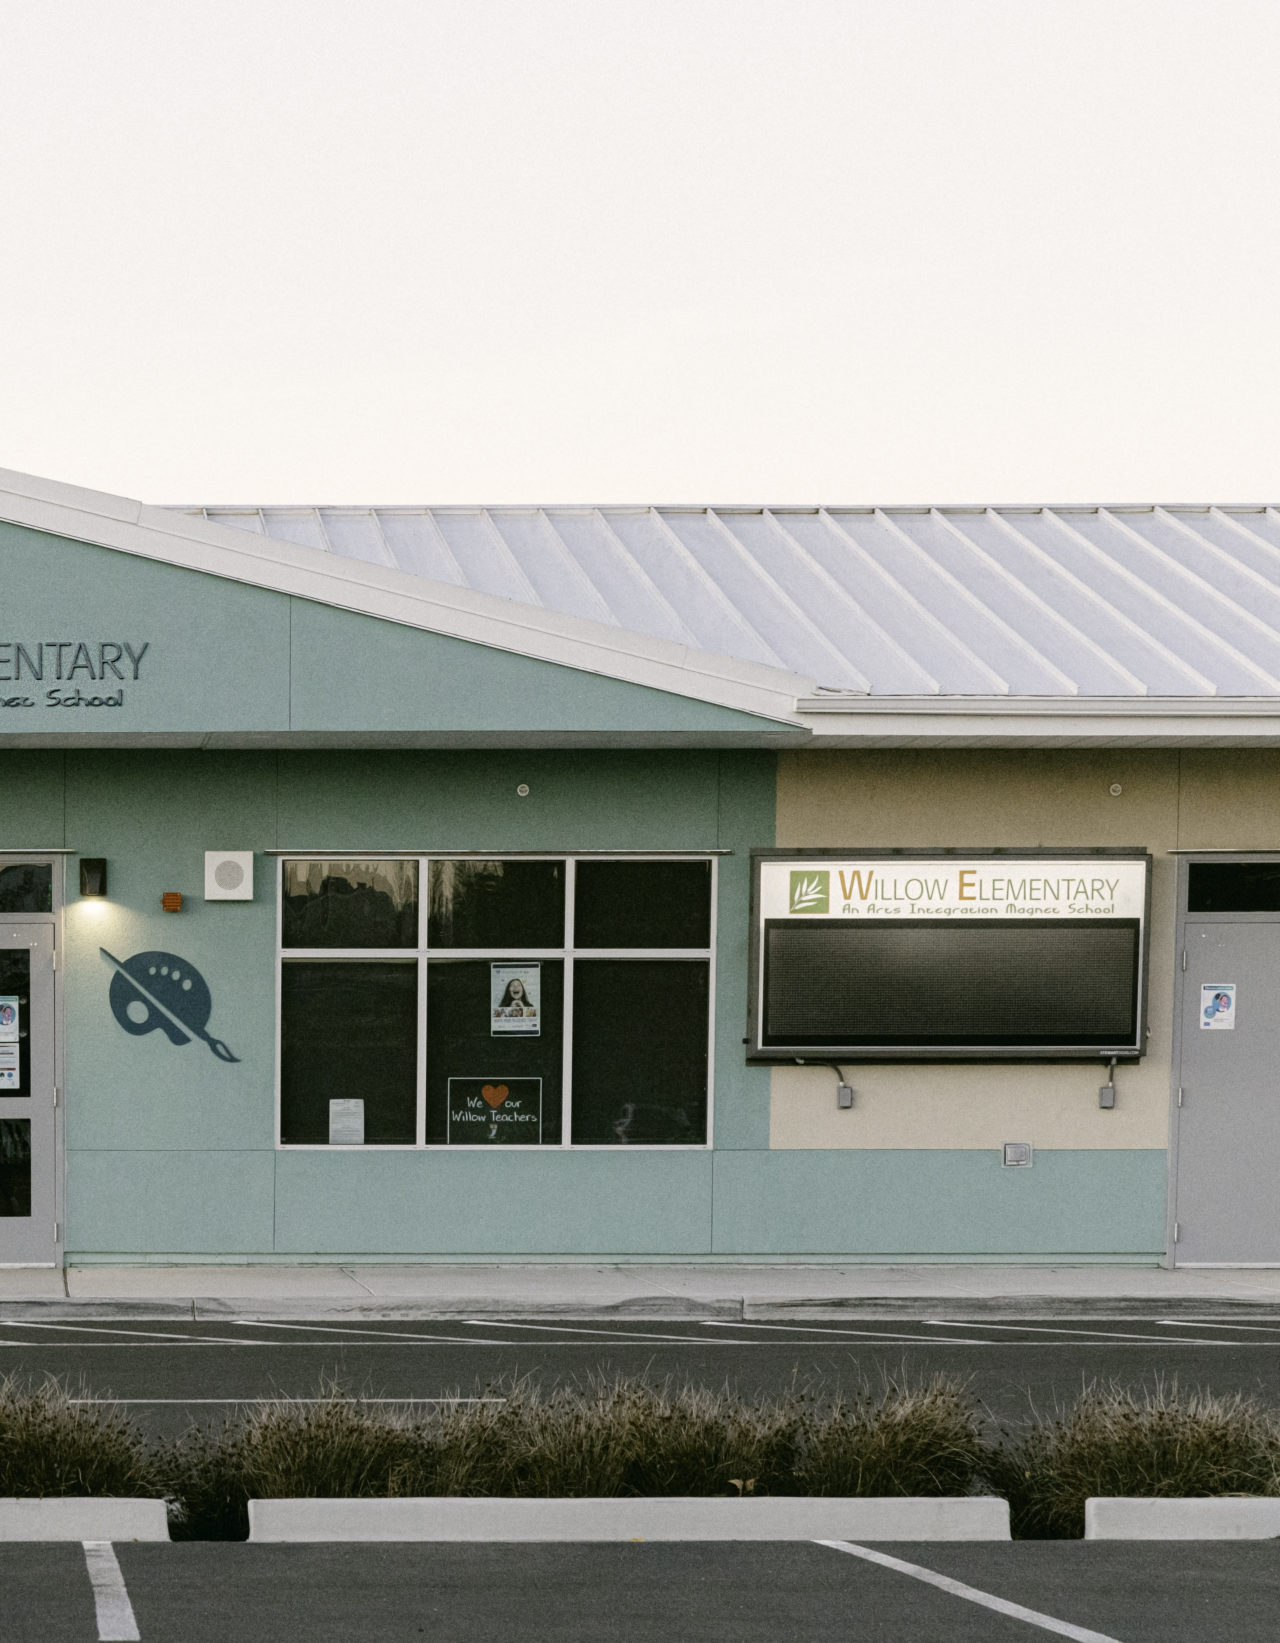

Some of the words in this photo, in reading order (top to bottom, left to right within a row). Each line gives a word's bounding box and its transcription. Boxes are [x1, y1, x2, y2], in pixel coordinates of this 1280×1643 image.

[46, 688, 123, 708] School
[838, 870, 949, 900] WILLOW
[958, 870, 1120, 900] ELEMENTARY
[842, 903, 859, 914] An
[867, 903, 901, 914] Arts
[909, 903, 998, 916] Integration
[1005, 903, 1060, 916] Magnet
[1068, 902, 1115, 914] School
[466, 1096, 483, 1108] We
[504, 1100, 522, 1108] our
[451, 1110, 486, 1122] Willow
[490, 1109, 537, 1122] Teachers
